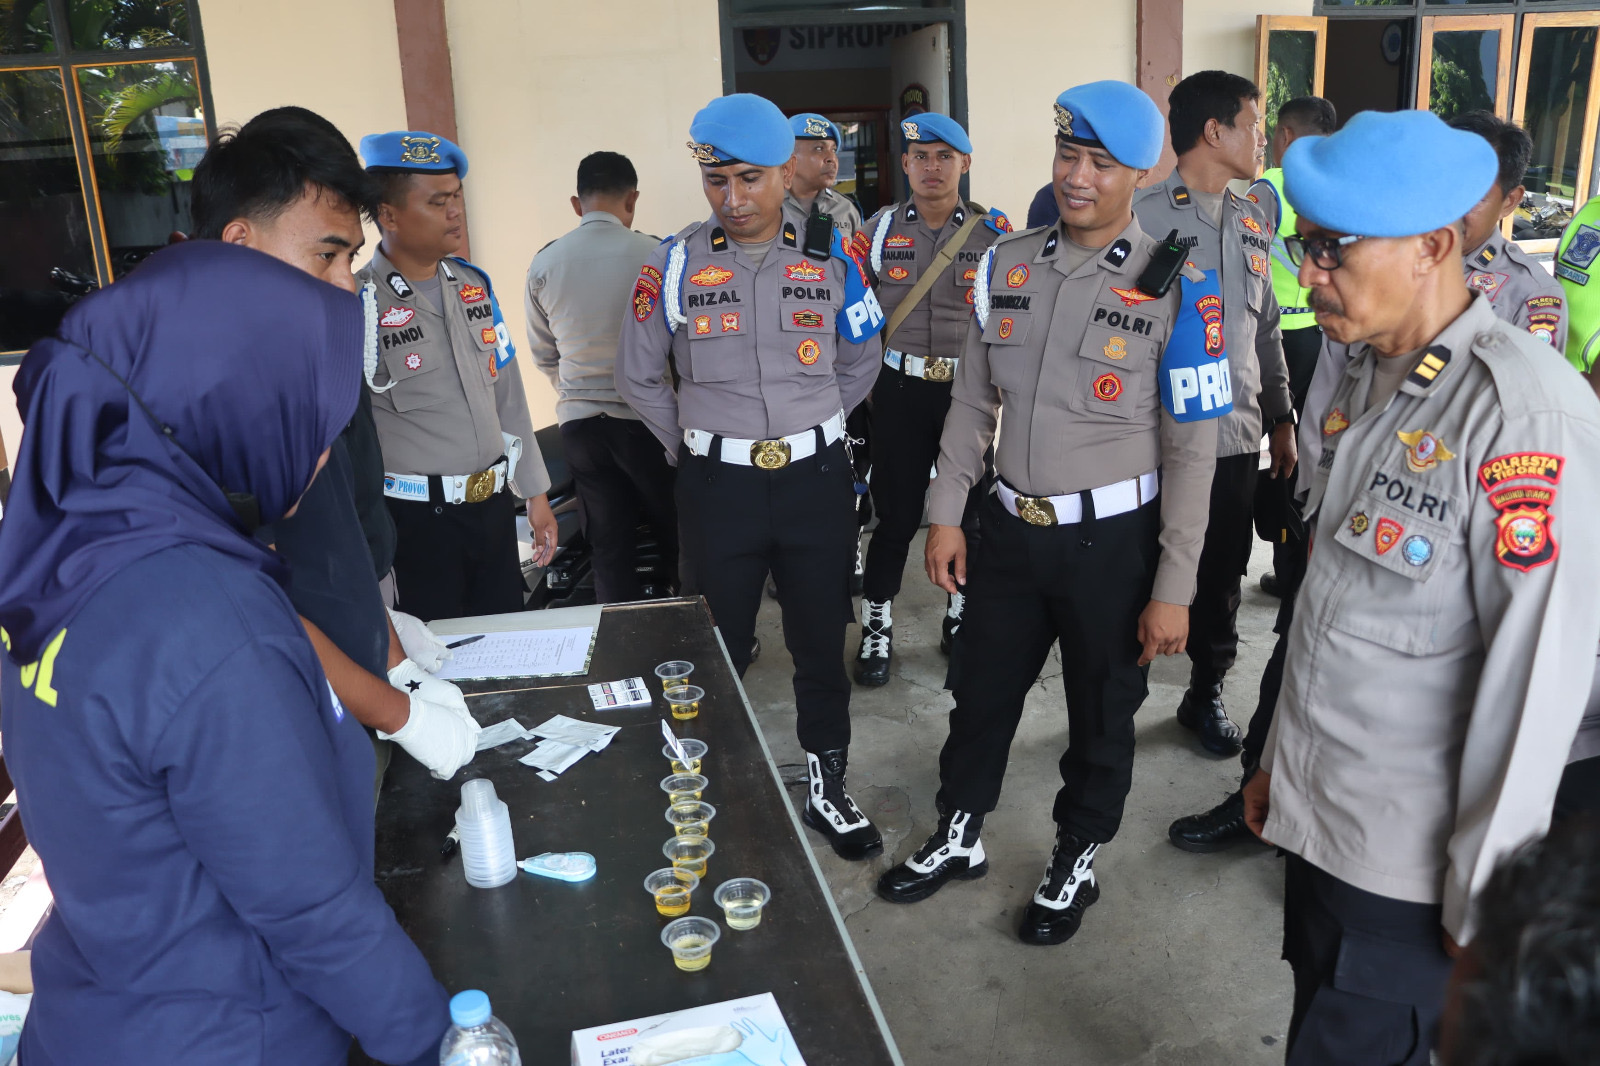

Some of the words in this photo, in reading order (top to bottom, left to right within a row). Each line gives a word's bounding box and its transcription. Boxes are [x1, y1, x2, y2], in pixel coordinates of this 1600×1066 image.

[958, 251, 984, 262] POL
[688, 290, 741, 308] RIZAL
[782, 286, 831, 301] POLRI
[466, 303, 493, 321] POLRI
[1198, 297, 1219, 310] POLDA
[1094, 307, 1153, 336] POLRI
[382, 325, 424, 350] FANDI
[1483, 455, 1558, 480] POLRESTA
[1493, 466, 1546, 481] TIDORE
[398, 480, 426, 495] PROVOS
[1369, 471, 1447, 522] POLRI
